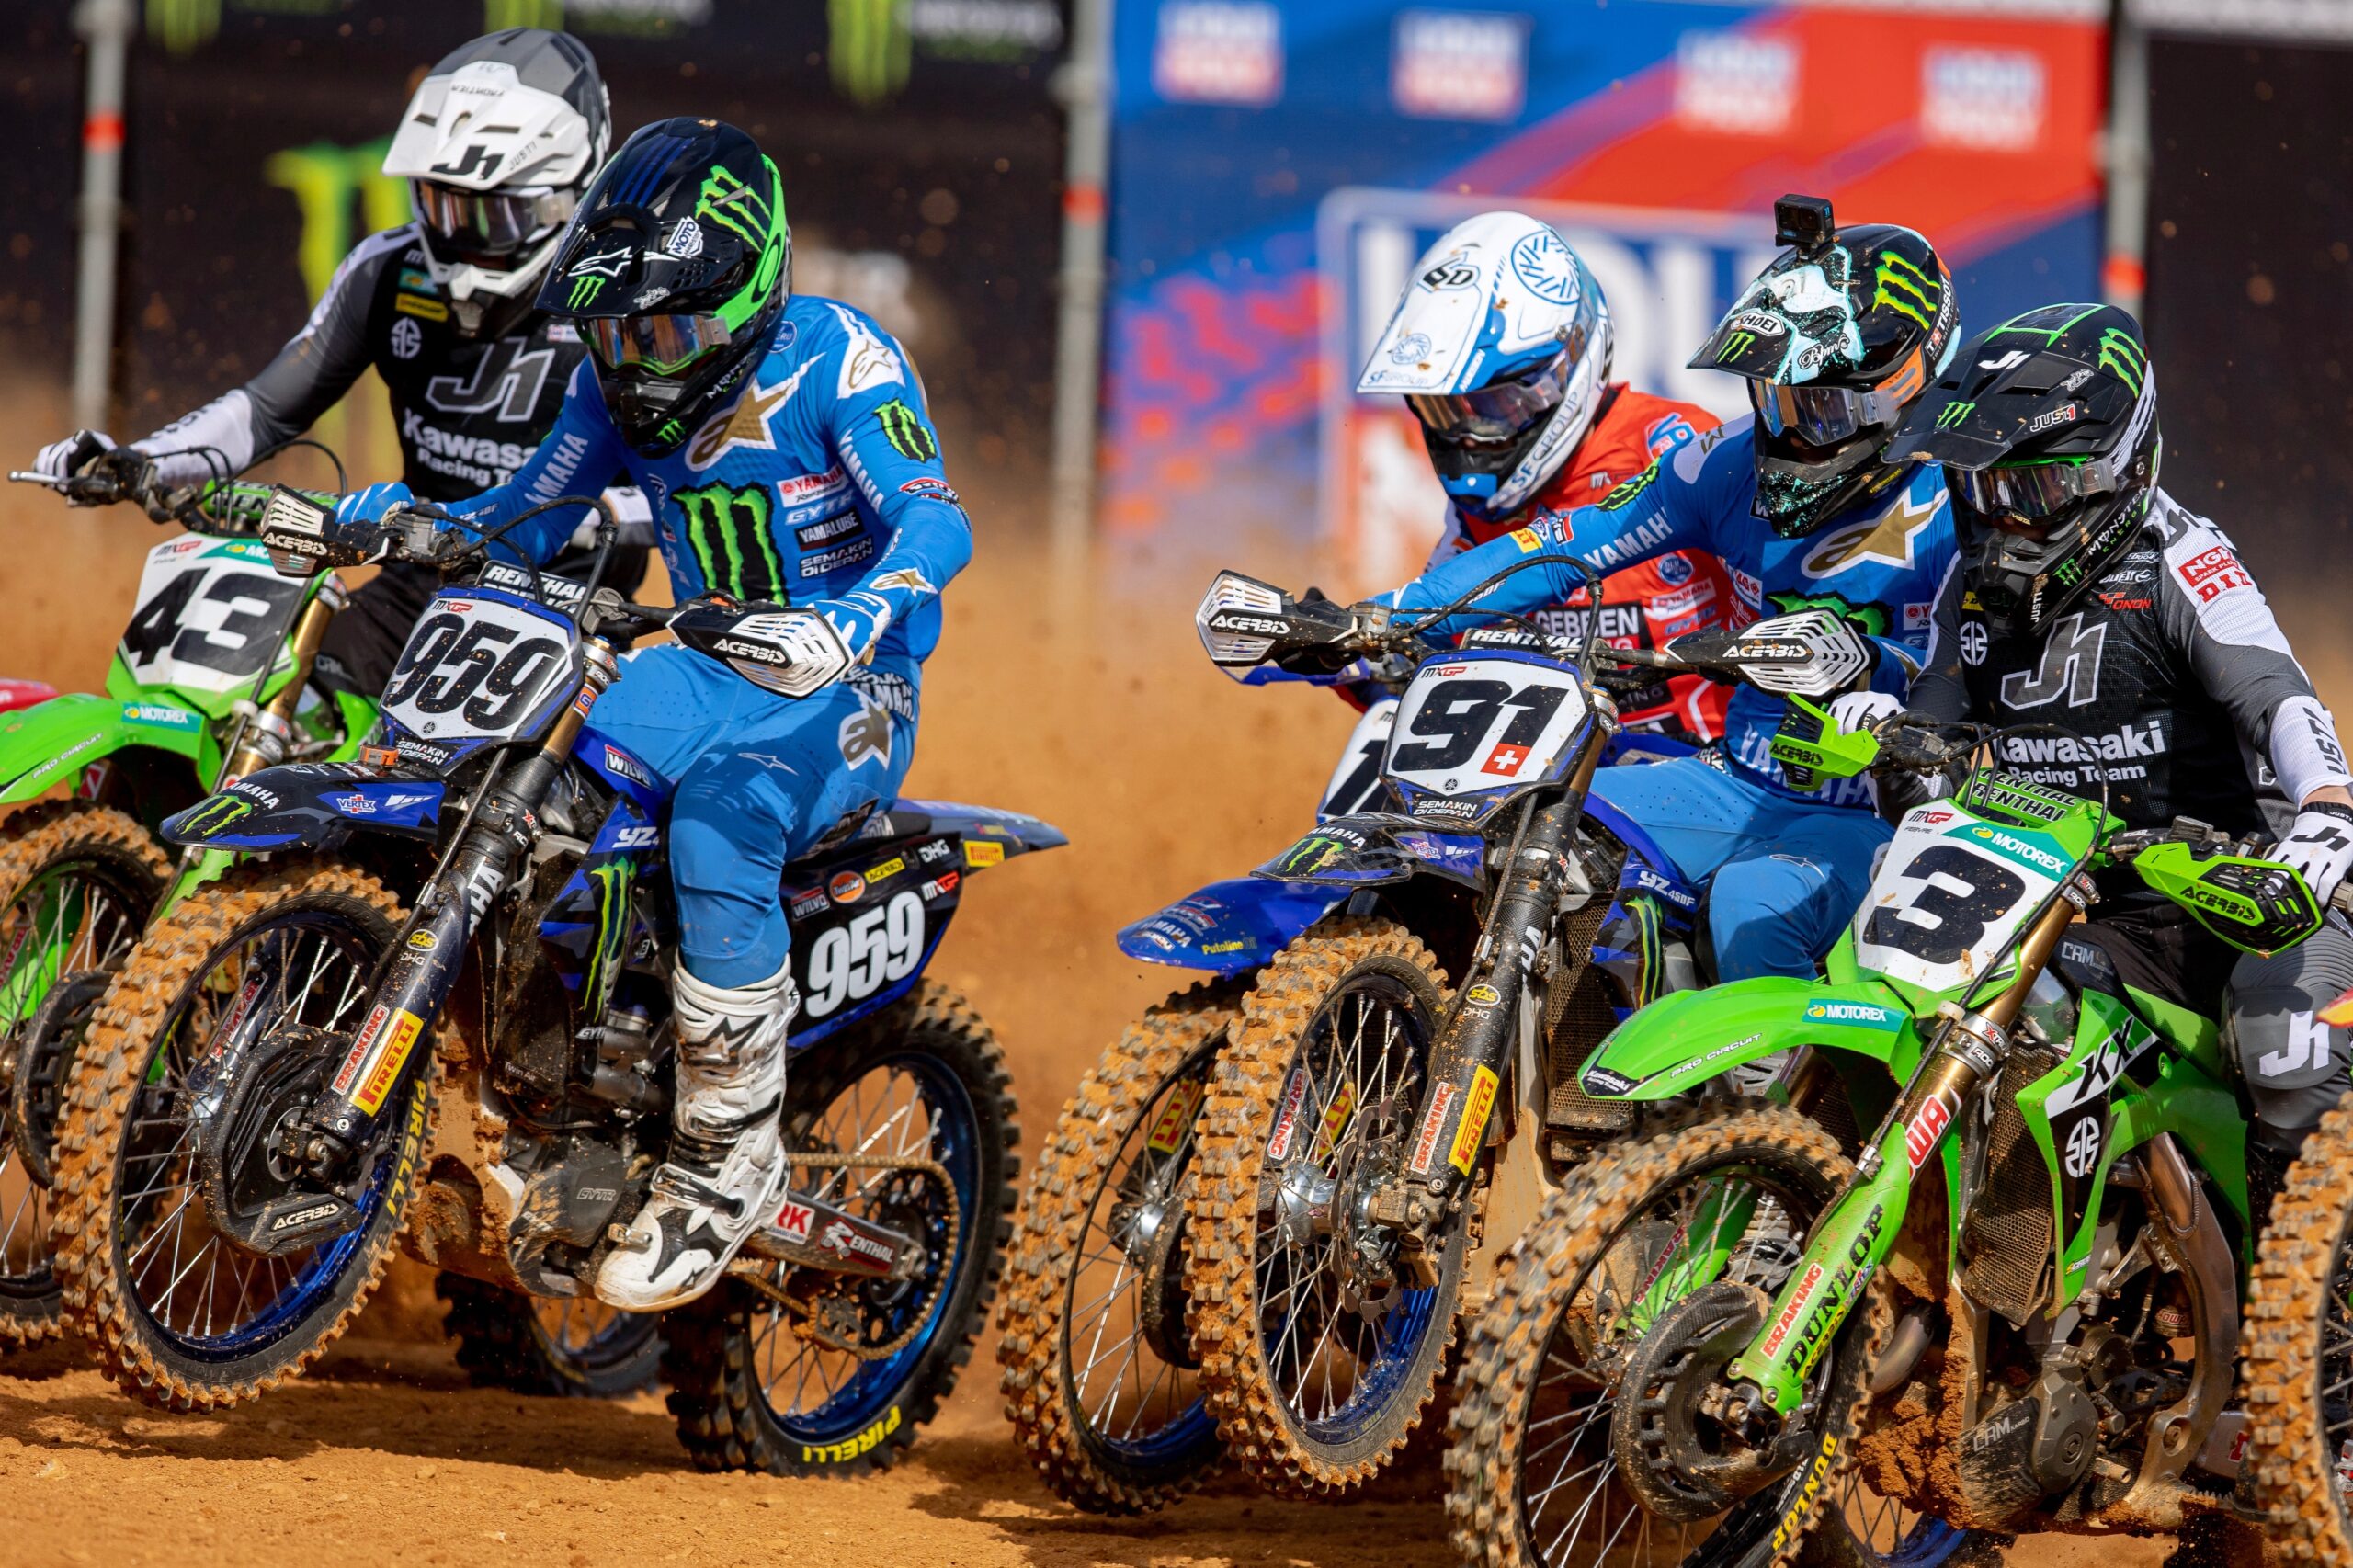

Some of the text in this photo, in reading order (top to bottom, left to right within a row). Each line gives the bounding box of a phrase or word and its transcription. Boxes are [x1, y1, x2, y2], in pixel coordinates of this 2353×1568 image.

[1936, 274, 1952, 331] TISSOT
[1740, 312, 1778, 332] SHOEI
[2029, 403, 2076, 433] JUST1
[404, 408, 543, 469] Kawasa
[1510, 388, 1580, 489] SF GROUP
[416, 449, 491, 488] Racing
[794, 465, 844, 488] YAMAHA
[261, 531, 329, 556] ACERBIS
[799, 512, 859, 544] YAMALUBE
[2194, 566, 2218, 582] SPARK
[122, 566, 301, 677] 43
[432, 598, 474, 614] MXGP
[1210, 613, 1290, 635] ACERBIS
[1471, 628, 1585, 650] RENTHAL
[712, 637, 787, 665] ACERBIS
[1722, 643, 1810, 659] ACERBIS
[380, 612, 568, 731] 959
[1420, 665, 1468, 679] MXGP
[139, 704, 189, 724] MOTOREX
[1390, 678, 1572, 773] 91
[30, 732, 105, 780] PRO CIRCUIT
[396, 741, 449, 759] SEMAKIN
[1770, 742, 1825, 767] ACERBIS
[1998, 721, 2168, 765] Kawasaki
[2008, 762, 2147, 788] Racing Team
[230, 780, 281, 811] AMAHA
[337, 798, 376, 810] VERTEX
[1417, 801, 1478, 812] SEMAKIN
[1907, 810, 1955, 824] MXGP
[612, 827, 654, 847] YZ
[919, 838, 950, 864] DHG
[1990, 832, 2068, 875] MOTOREX
[920, 870, 961, 902] MXGP
[1637, 869, 1696, 908] YZ 450F
[1861, 844, 2027, 965] 3
[2180, 885, 2258, 920] ACERBIS
[399, 951, 426, 965] DHG
[804, 890, 926, 1018] 959
[2061, 941, 2095, 966] CRM
[1461, 1006, 1491, 1020] DHG
[1825, 1003, 1887, 1023] MOTOREX
[576, 1027, 607, 1040] GYT
[335, 1006, 386, 1093] BRAKING
[359, 1017, 415, 1107] PIRELLI
[1669, 1031, 1763, 1079] PRO CIRCUIT
[2070, 1014, 2139, 1105] KX
[504, 1061, 524, 1074] Twin
[1587, 1069, 1631, 1091] Kawasaki
[1415, 1085, 1452, 1170] BRAKING
[1458, 1075, 1495, 1166] PIRELLI
[386, 1078, 427, 1217] PIRELLI
[271, 1201, 340, 1232] ACERBIS
[821, 1220, 894, 1264] RENTHAL
[1785, 1202, 1883, 1377] DUNLOP
[1763, 1264, 1823, 1357] BRAKING
[801, 1404, 903, 1464] PIRELLI
[1972, 1416, 2012, 1454] CRM
[1772, 1431, 1838, 1552] DUNLOP
